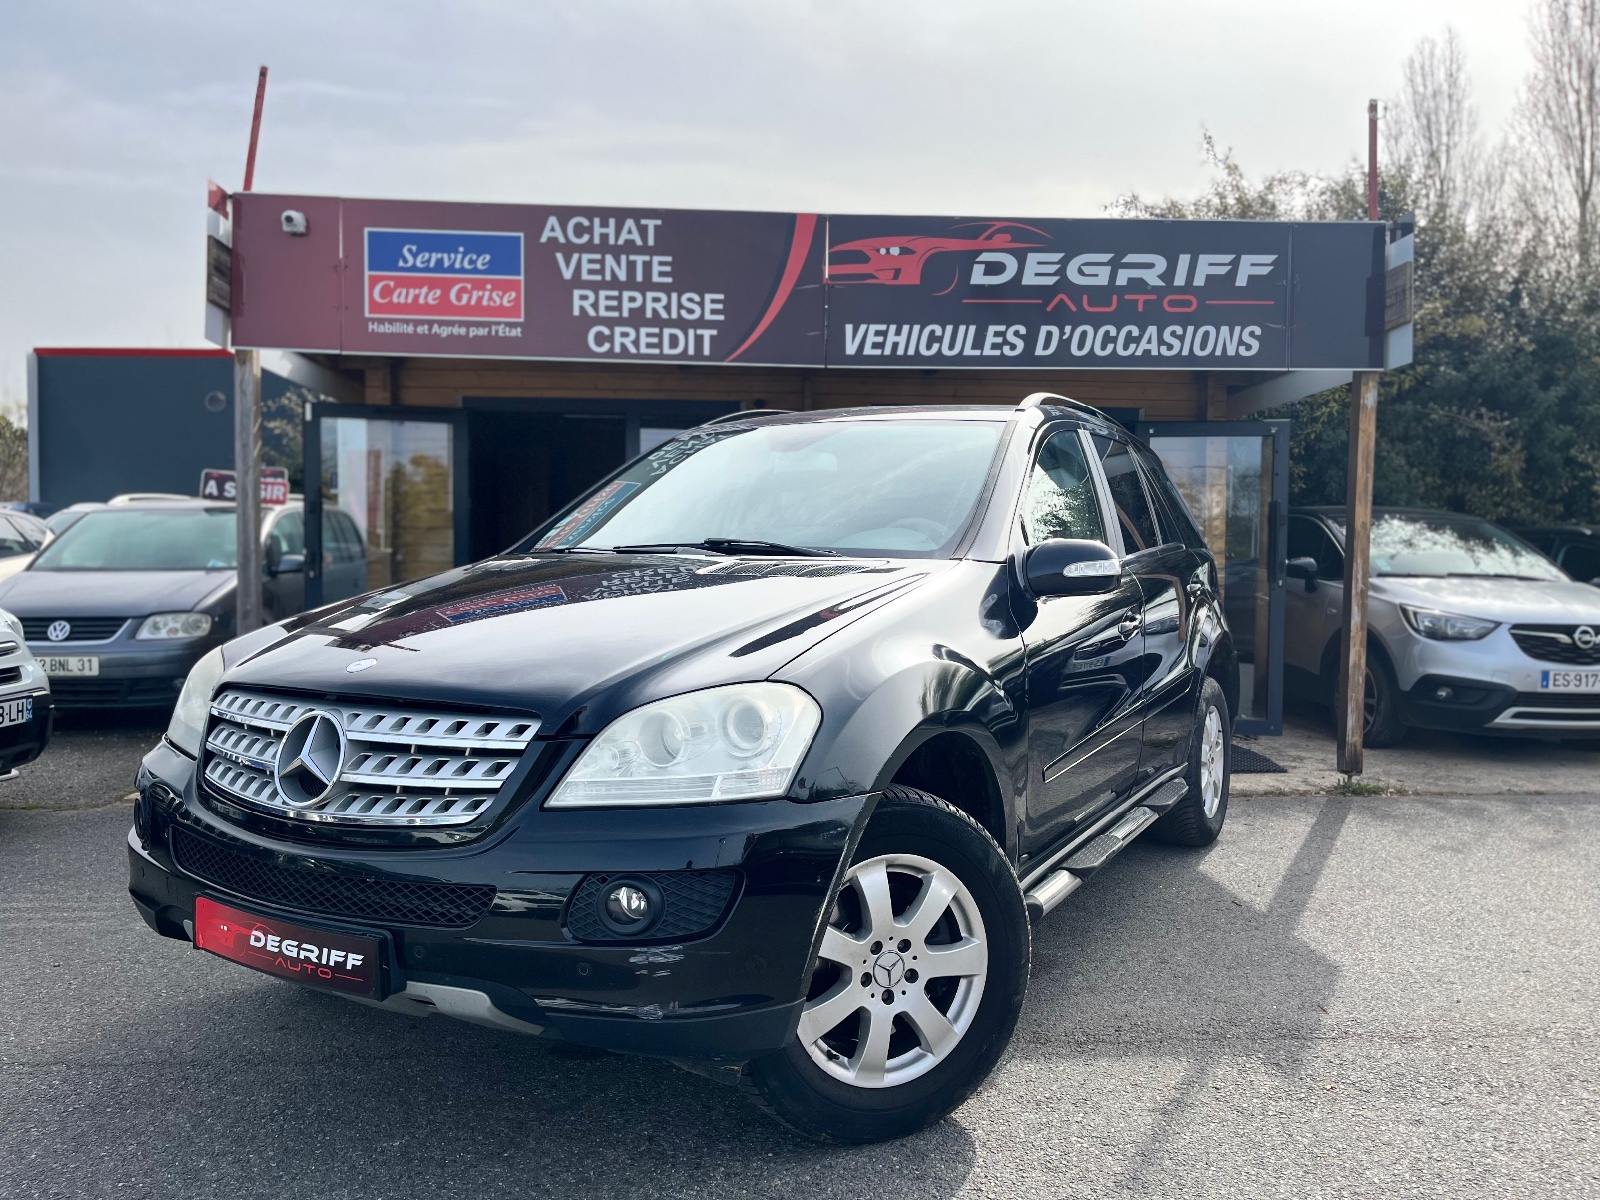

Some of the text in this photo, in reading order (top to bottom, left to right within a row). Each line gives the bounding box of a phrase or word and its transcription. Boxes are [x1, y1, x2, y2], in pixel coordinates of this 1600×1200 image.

[539, 215, 662, 246] ACHAT
[397, 243, 491, 270] Service
[554, 252, 673, 283] VENTE
[969, 252, 1279, 287] DEGRIFF
[372, 280, 516, 307] Carte Grise
[572, 289, 725, 321] REPRISE
[1046, 293, 1198, 313] AUTO
[368, 321, 414, 334] Habilité
[416, 323, 429, 335] et
[431, 323, 466, 338] Agrée
[469, 325, 489, 338] par
[587, 325, 718, 356] CREDIT
[845, 323, 1262, 357] VEHICULES D'OCCASIONS
[204, 479, 219, 497] A
[50, 658, 73, 672] BNL
[77, 658, 92, 672] 31
[249, 929, 364, 970] DEGRIFF
[275, 957, 332, 979] AUTO
